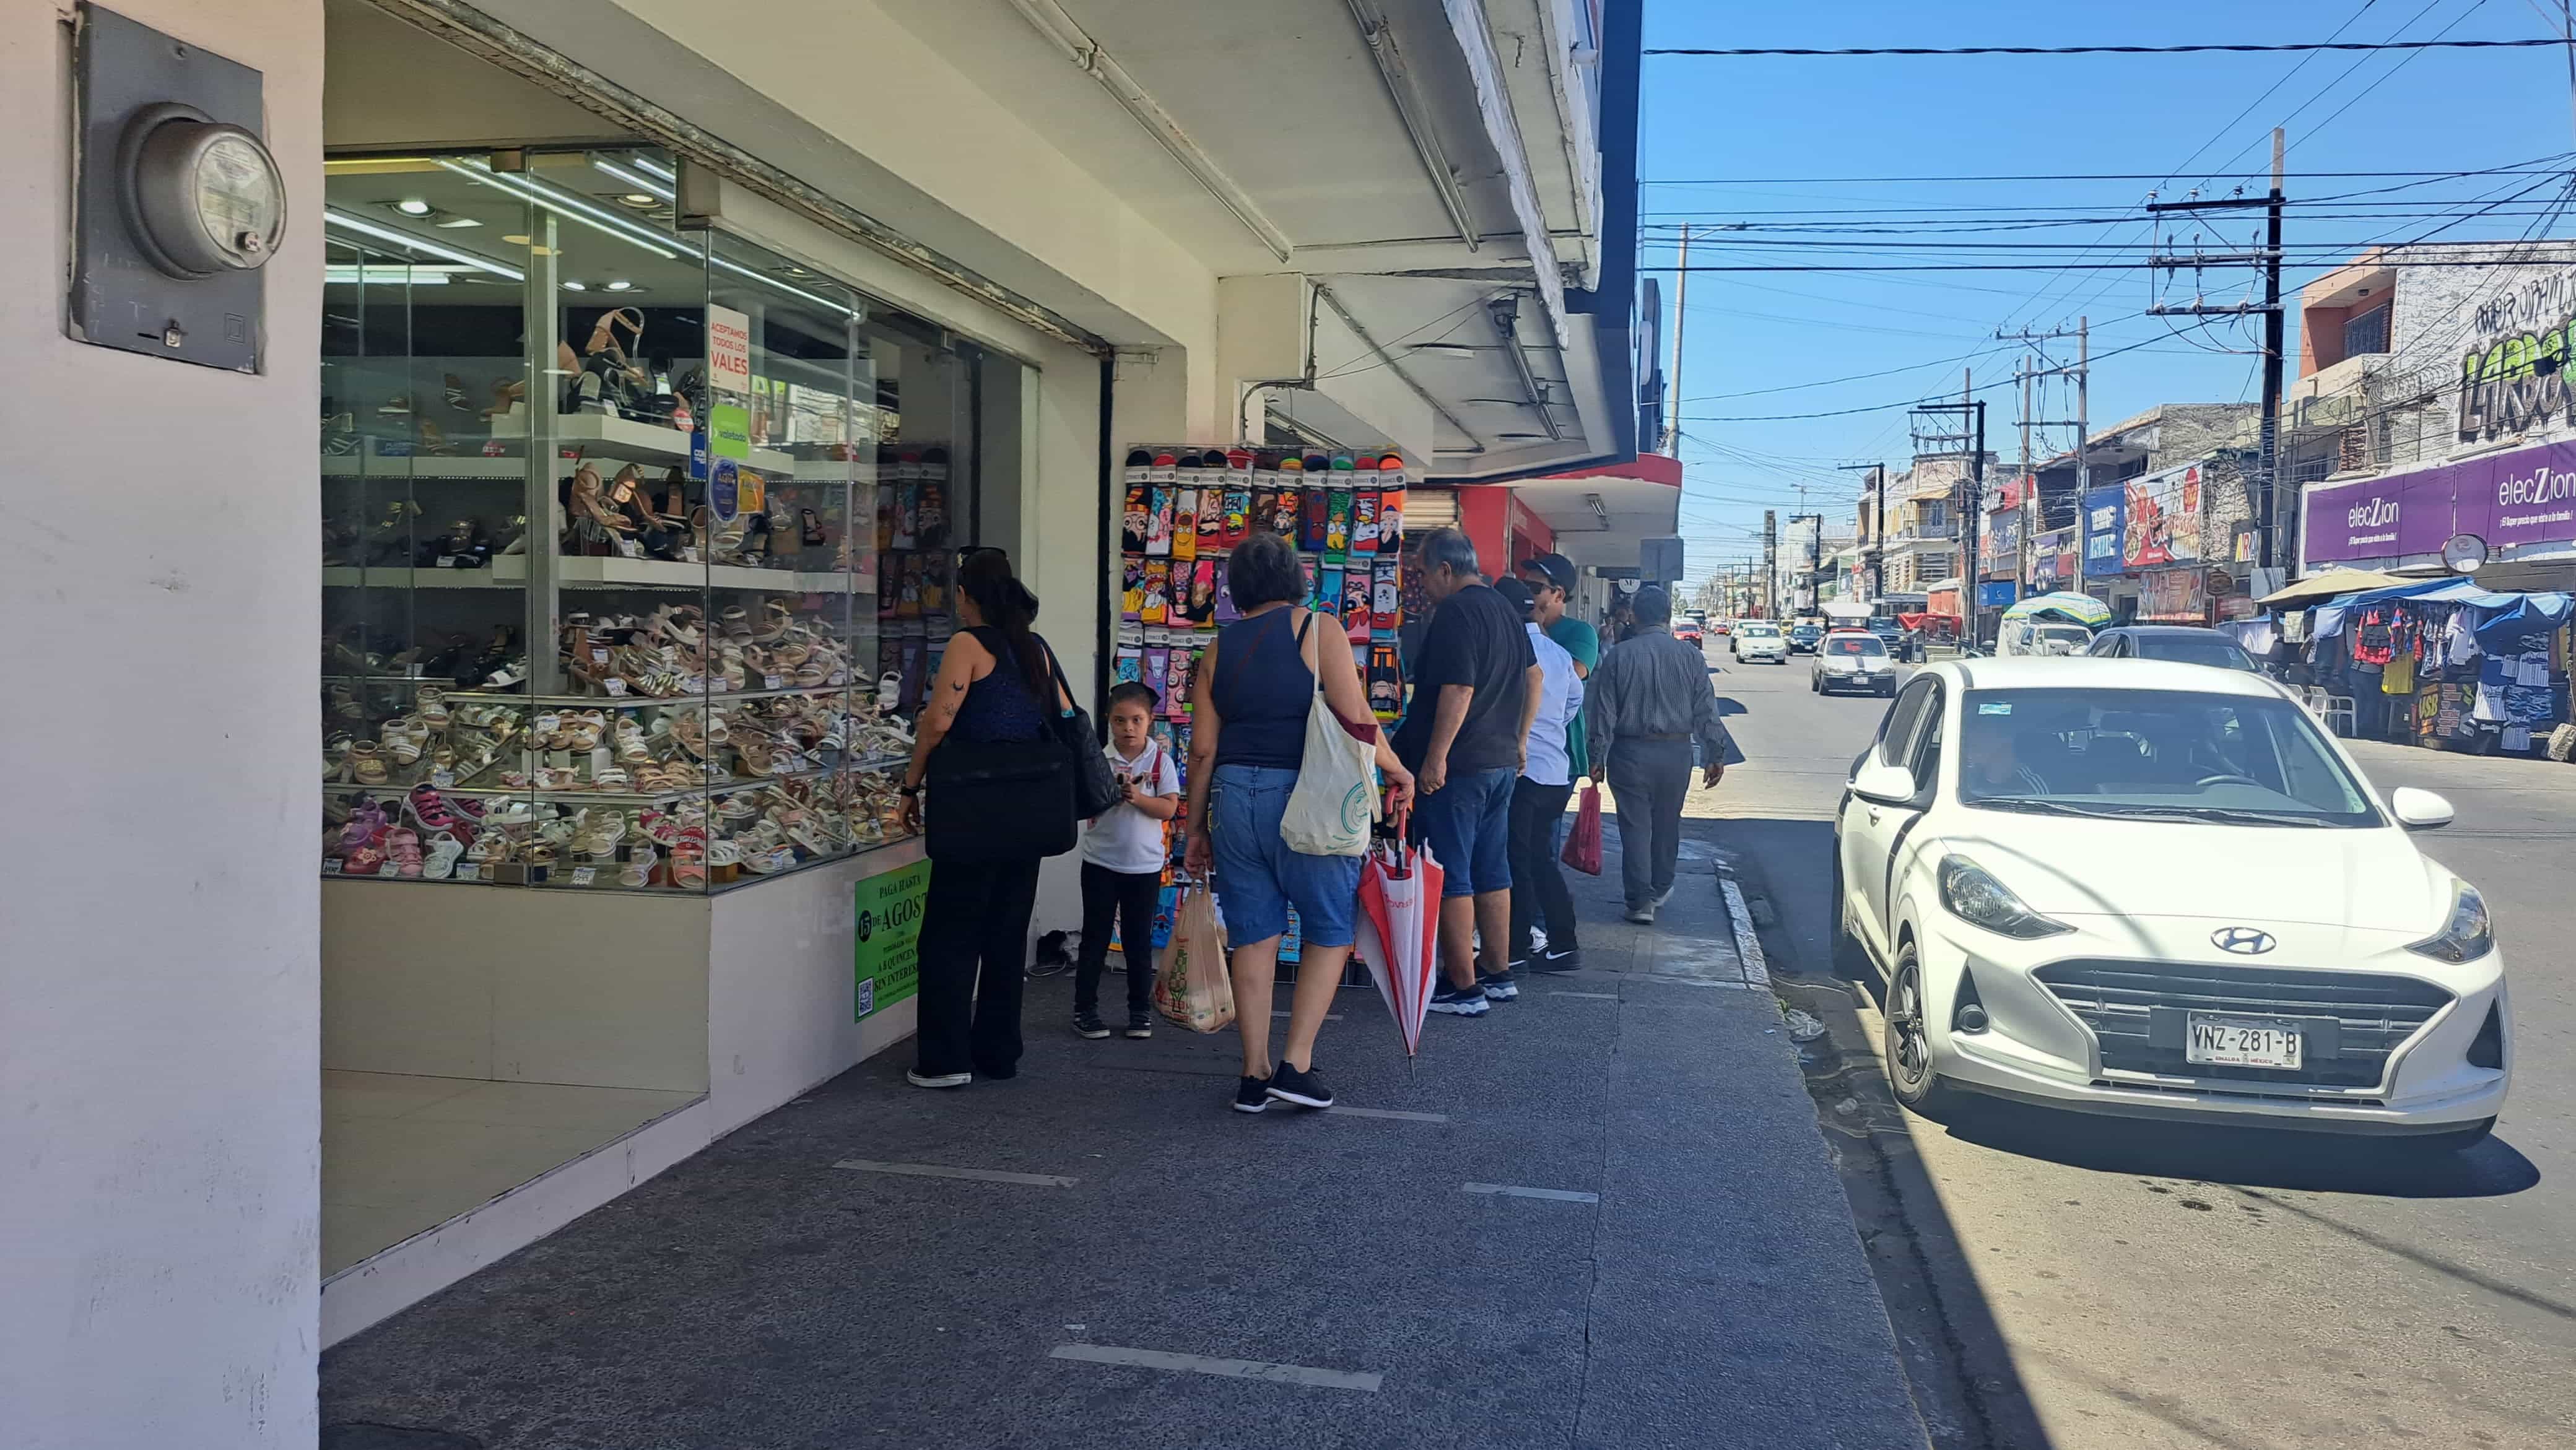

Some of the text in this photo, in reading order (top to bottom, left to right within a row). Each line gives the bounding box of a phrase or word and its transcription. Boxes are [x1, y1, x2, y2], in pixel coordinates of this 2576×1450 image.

[712, 322, 747, 340] ACEPTAMOS
[713, 336, 746, 353] TODOS LOS
[711, 350, 747, 375] VALES
[2499, 467, 2576, 506] elecZion
[2348, 497, 2399, 528] elecZion
[879, 875, 921, 899] PAGA HASTA
[872, 892, 927, 932] DE AGOST
[860, 915, 871, 937] 15
[887, 947, 918, 970] QUINCEN
[874, 976, 887, 992] SIN
[2193, 1025, 2297, 1054] VNZ-281-B
